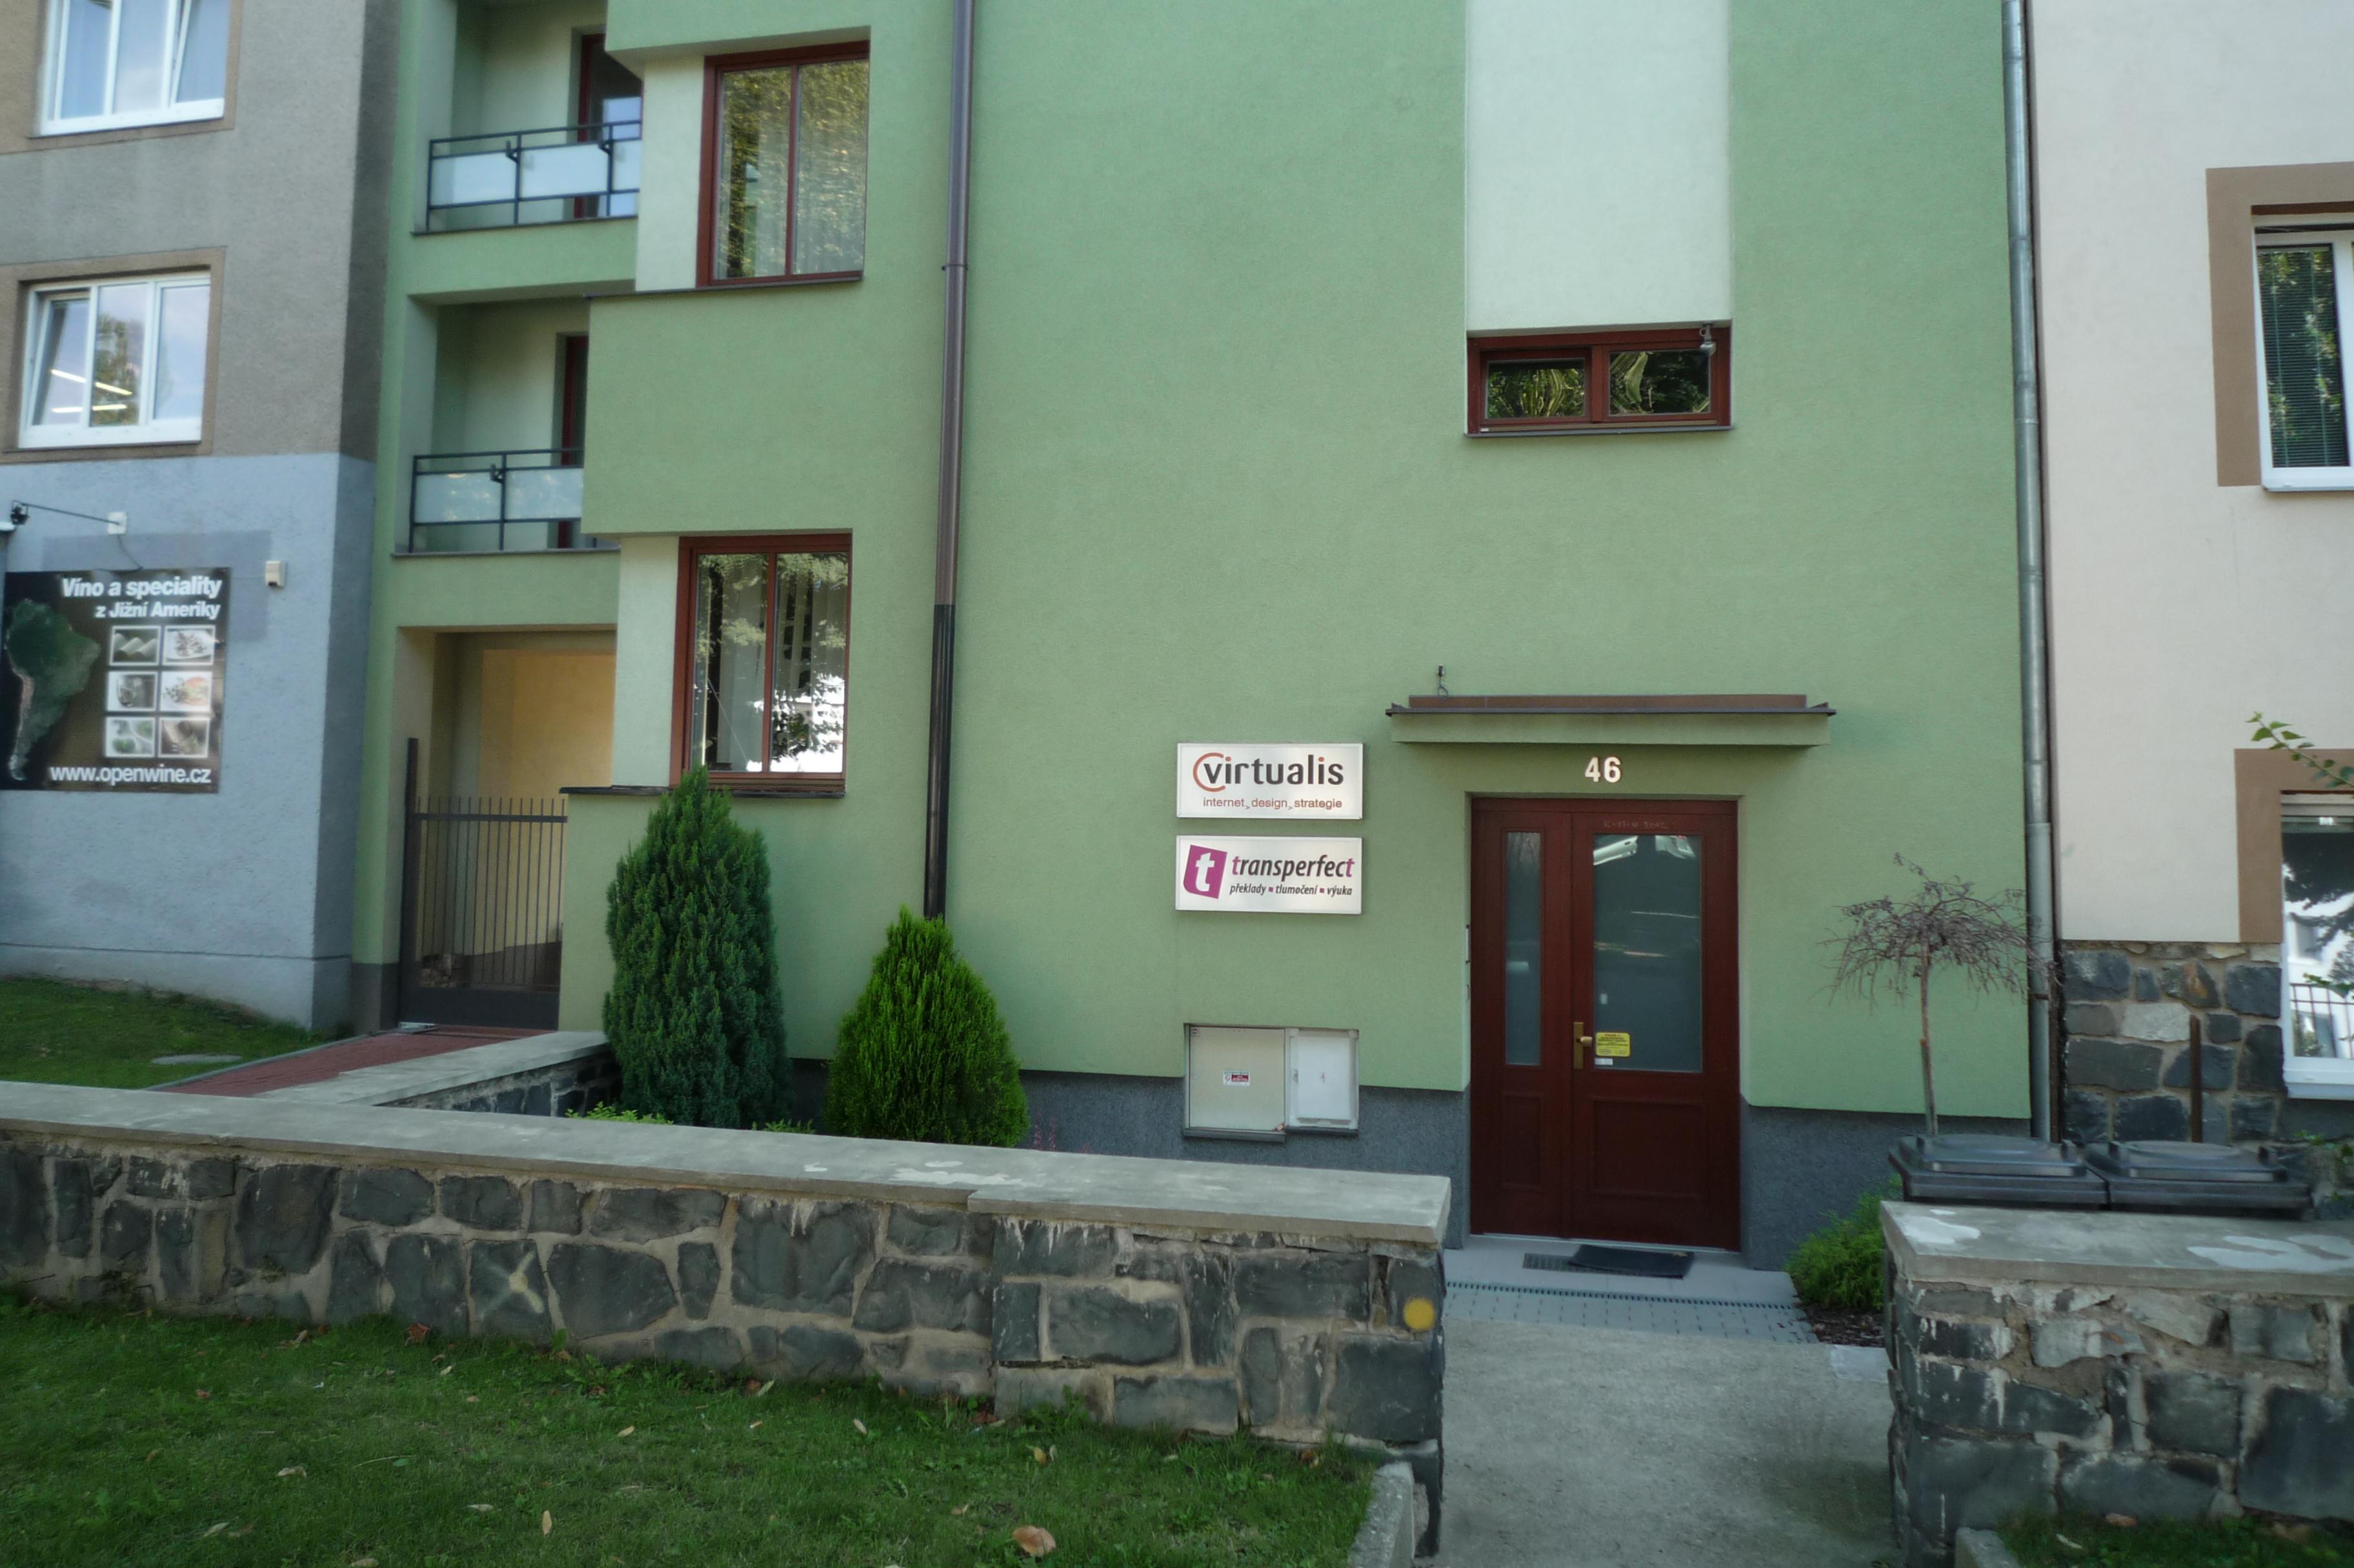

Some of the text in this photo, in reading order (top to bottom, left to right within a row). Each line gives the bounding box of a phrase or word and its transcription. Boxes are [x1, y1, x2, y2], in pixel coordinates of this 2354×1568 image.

[63, 576, 223, 600] Víno a speciality
[96, 601, 221, 620] z Jižní Ameriky
[50, 763, 212, 786] www.openwine.cz
[1203, 754, 1344, 785] virtualis
[1584, 756, 1622, 783] 46
[1203, 797, 1343, 810] internet design strategie
[1195, 852, 1216, 892] t
[1231, 854, 1355, 882] transperfect
[1229, 883, 1353, 898] překlady tlumočení výuka
